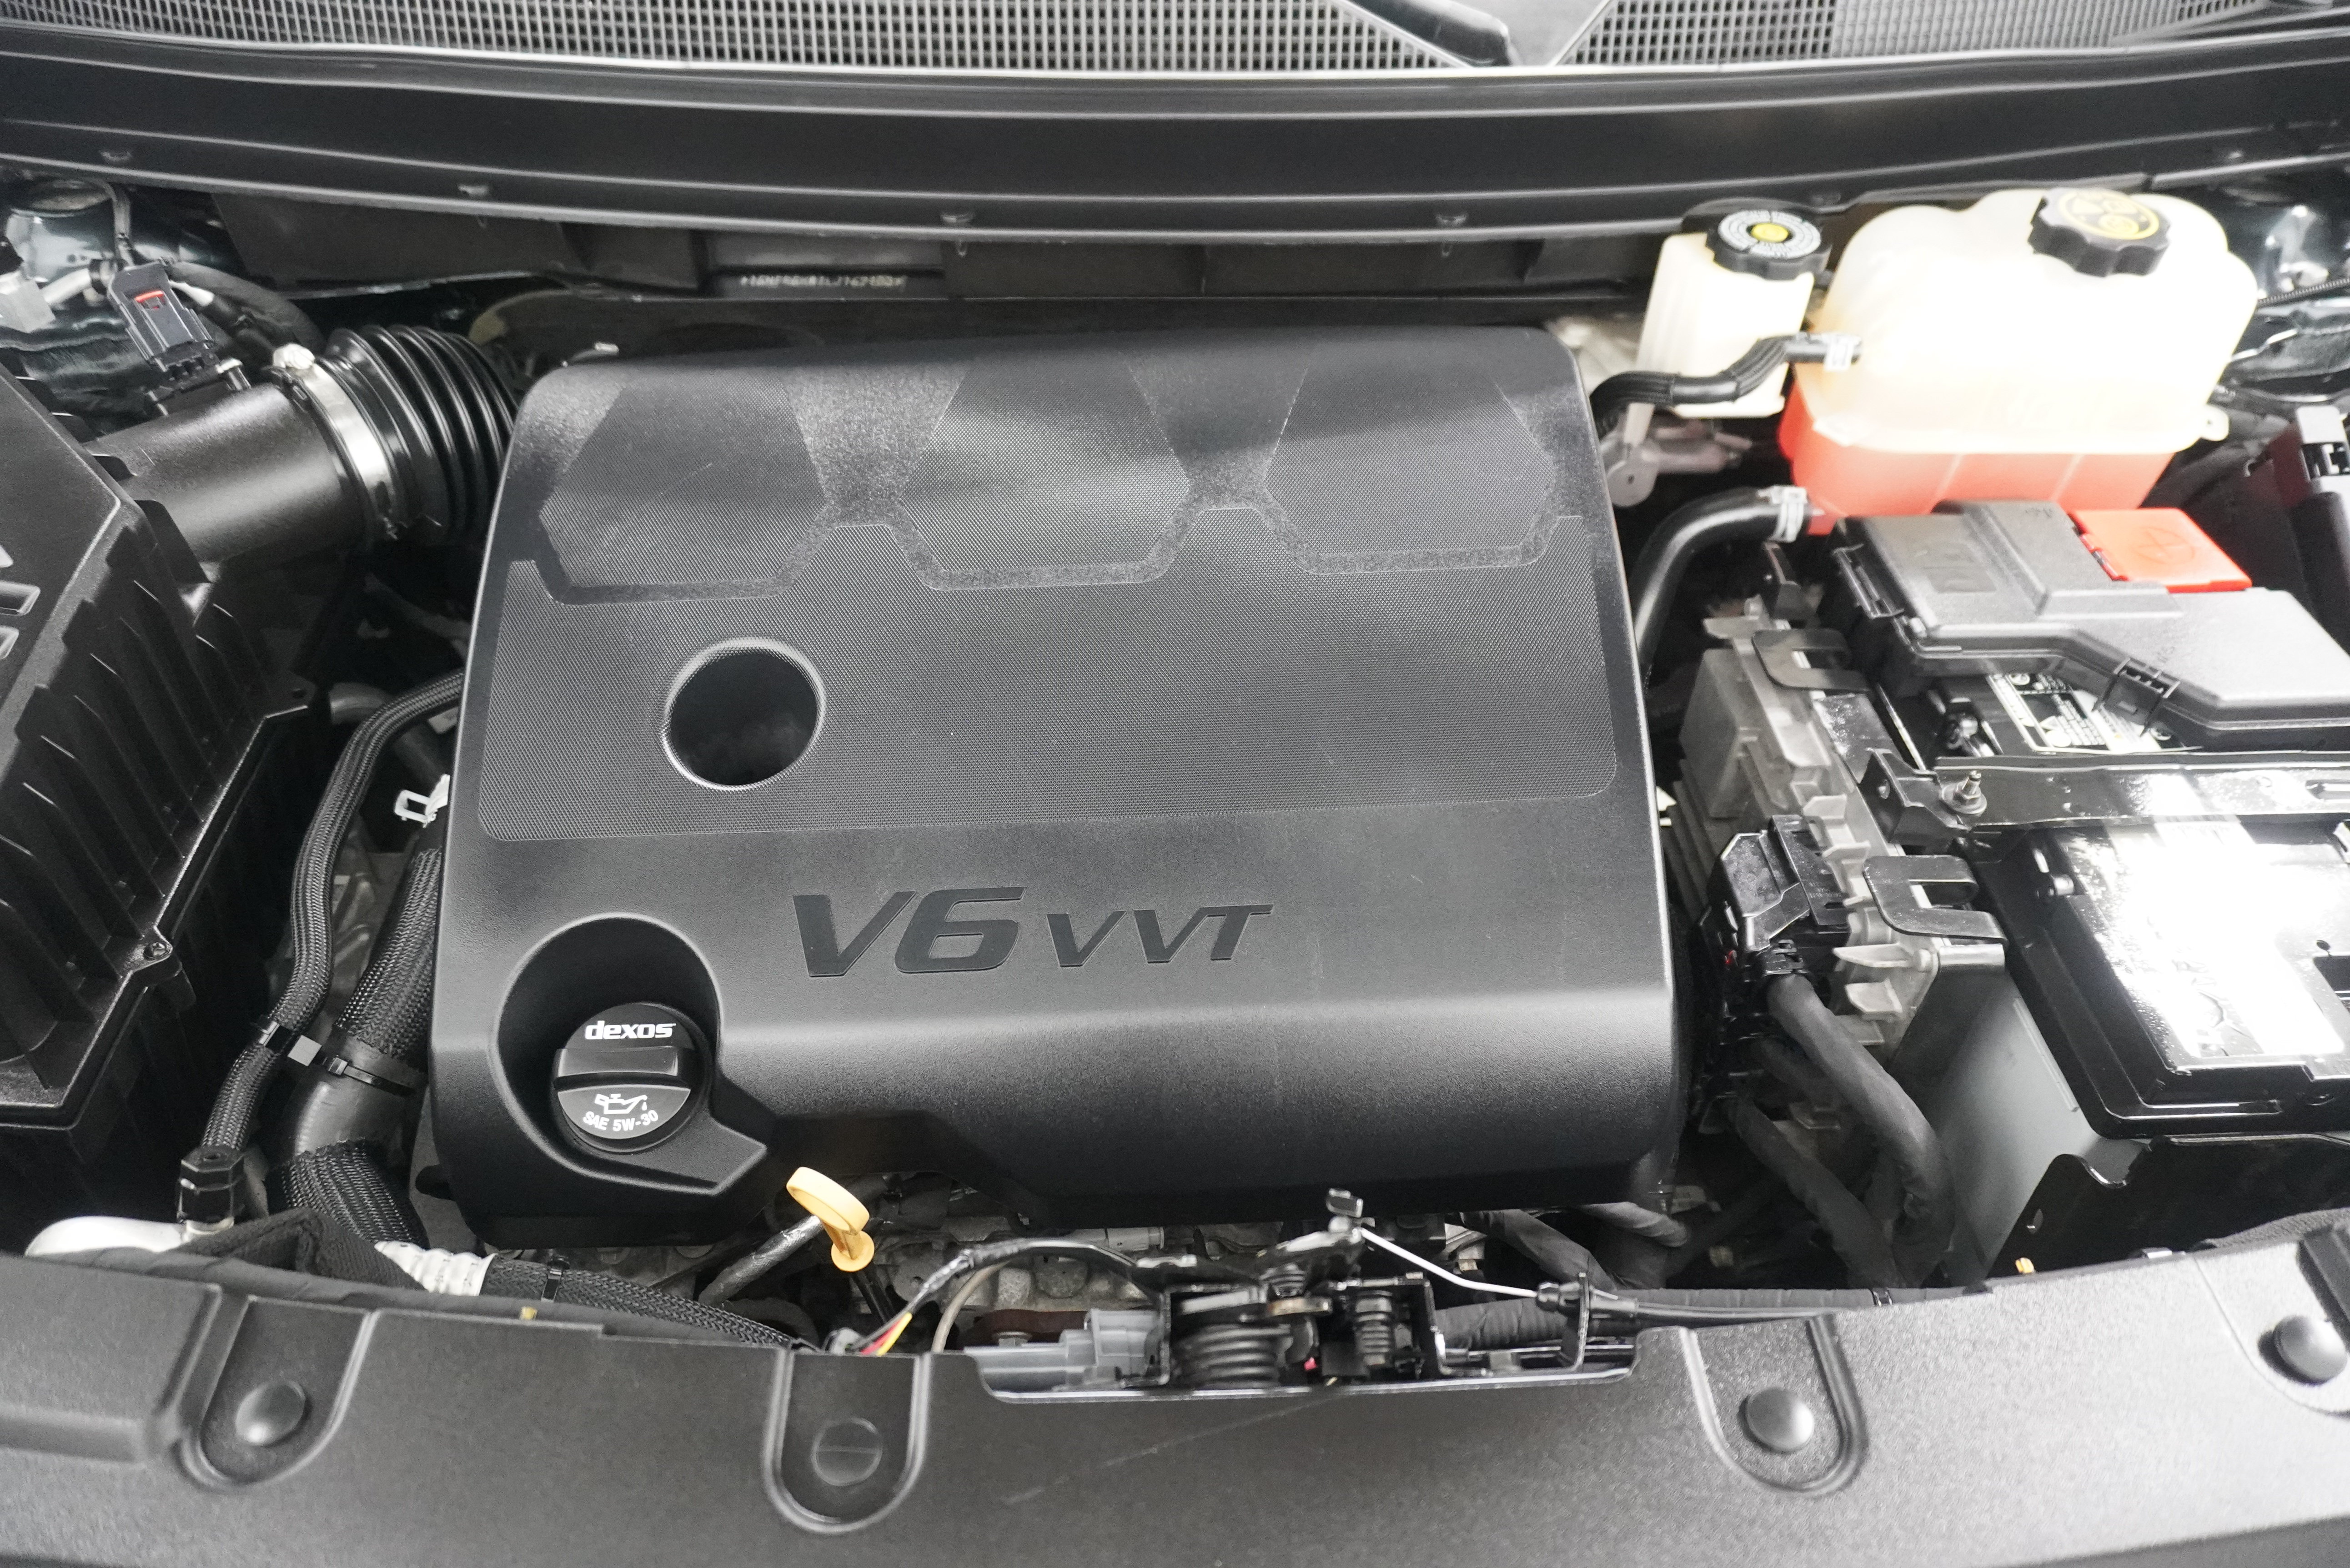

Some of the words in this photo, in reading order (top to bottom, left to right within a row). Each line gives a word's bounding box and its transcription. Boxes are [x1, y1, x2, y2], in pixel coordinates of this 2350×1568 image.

[793, 886, 1027, 978] V6
[1046, 904, 1275, 967] VVT
[584, 1020, 677, 1040] dexos
[582, 1111, 610, 1131] SAE
[613, 1110, 659, 1132] 5W-30
